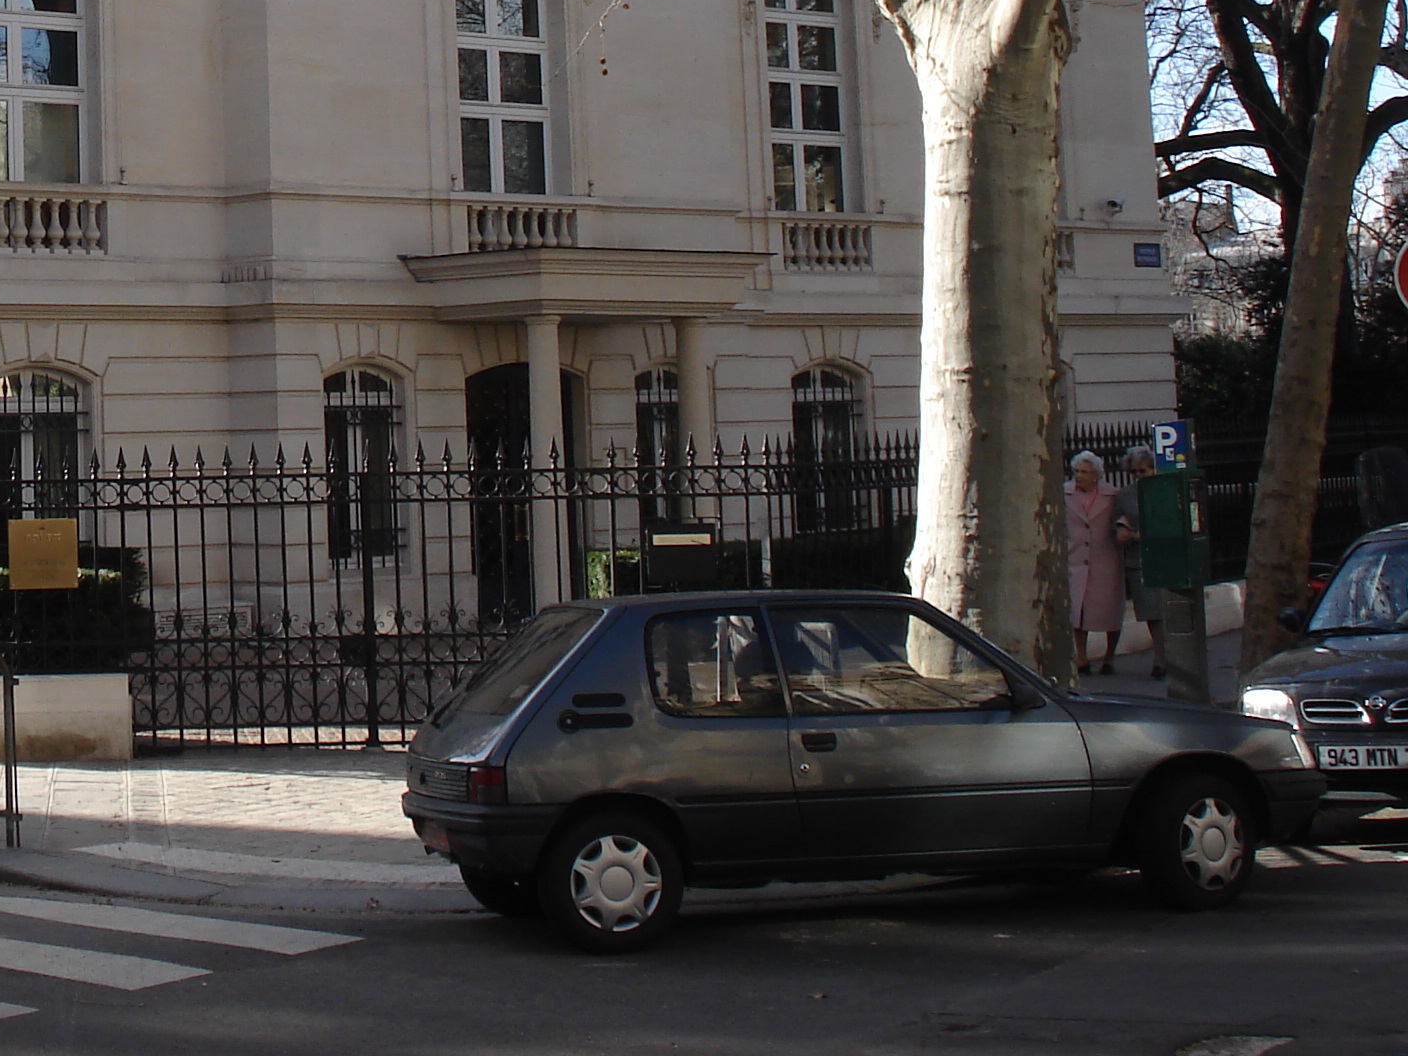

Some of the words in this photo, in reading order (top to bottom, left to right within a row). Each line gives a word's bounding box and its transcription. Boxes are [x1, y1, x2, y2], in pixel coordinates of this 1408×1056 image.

[1155, 425, 1177, 454] P
[1327, 748, 1359, 767] 943
[1366, 748, 1399, 767] MTN
